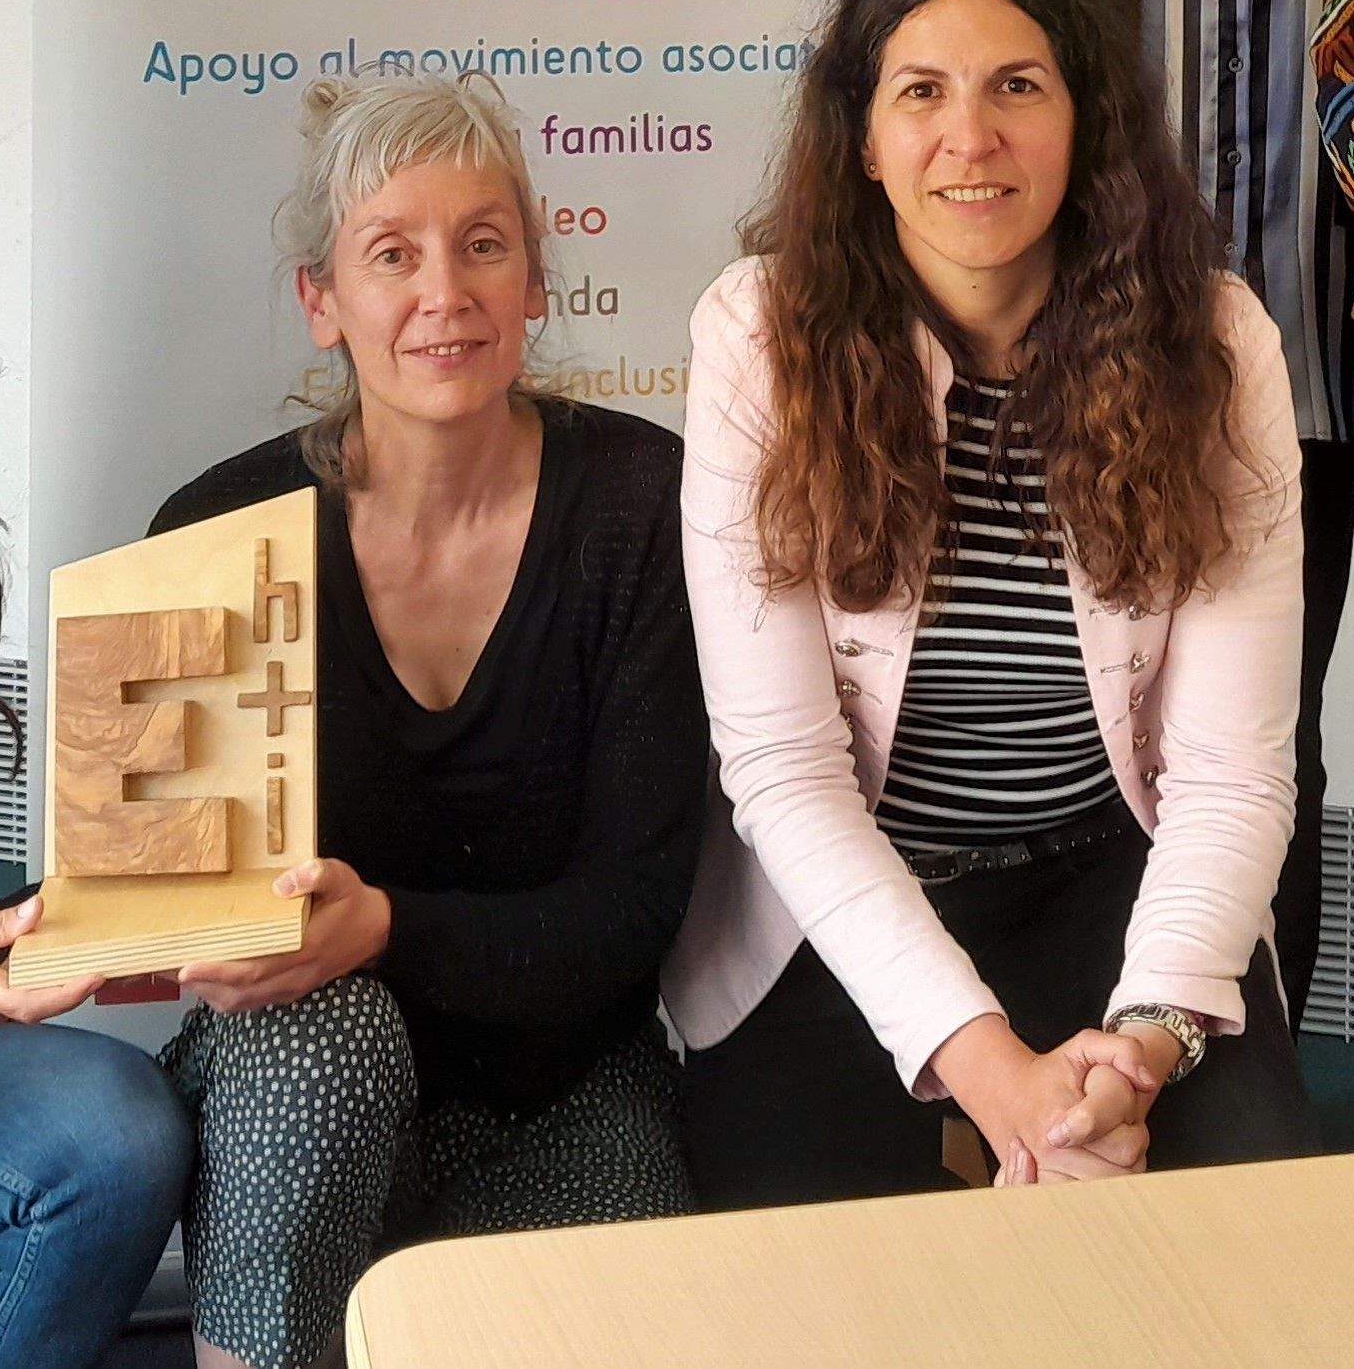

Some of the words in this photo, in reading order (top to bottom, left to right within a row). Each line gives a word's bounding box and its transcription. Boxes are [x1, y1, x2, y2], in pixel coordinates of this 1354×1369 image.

[144, 41, 299, 95] Apoyo
[320, 37, 359, 78] al
[379, 37, 642, 78] movimiento
[539, 113, 713, 155] familias
